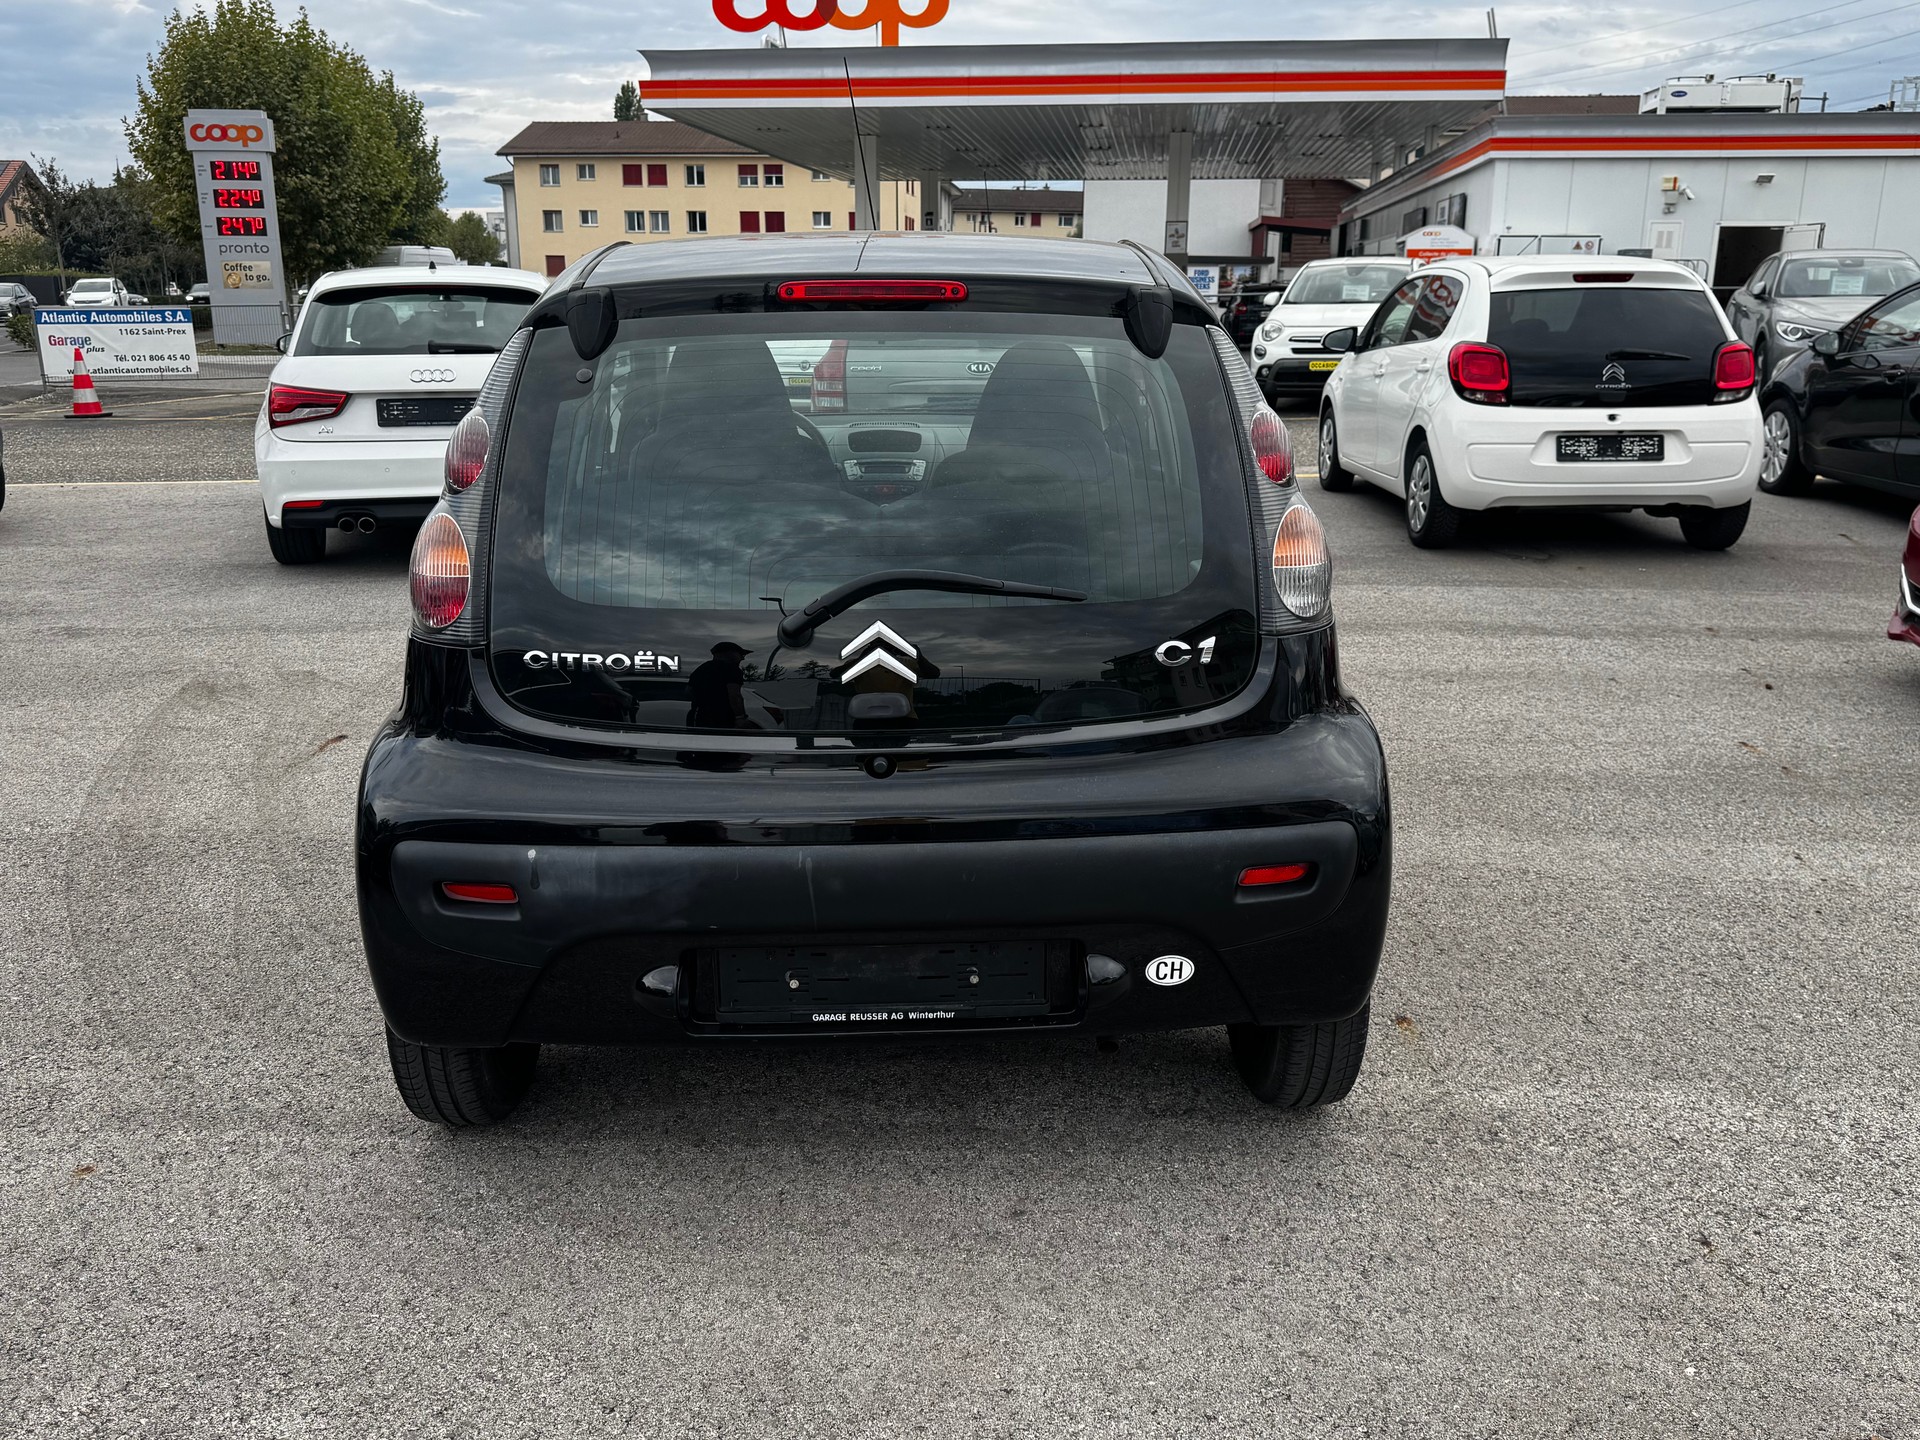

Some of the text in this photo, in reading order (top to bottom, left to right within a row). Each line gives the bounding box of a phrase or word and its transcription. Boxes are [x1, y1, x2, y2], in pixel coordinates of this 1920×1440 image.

[189, 123, 264, 148] coop
[218, 242, 270, 256] pronto
[223, 262, 254, 272] Coffee
[244, 272, 270, 283] to go.
[41, 310, 188, 323] Atlantic Automobiles S.A.
[119, 327, 187, 336] 1162 Saint-Prex
[48, 334, 92, 349] Garage
[86, 345, 105, 354] plus
[114, 353, 191, 362] Tél. 021 806 45 40
[67, 365, 192, 375] w.atlanticautomobiles.ch
[970, 364, 991, 372] KIA
[1155, 635, 1217, 667] C1
[522, 650, 681, 673] CITROËN
[1155, 961, 1184, 981] CH
[812, 1010, 955, 1022] GARAGE REUSSER AG Winterthur
